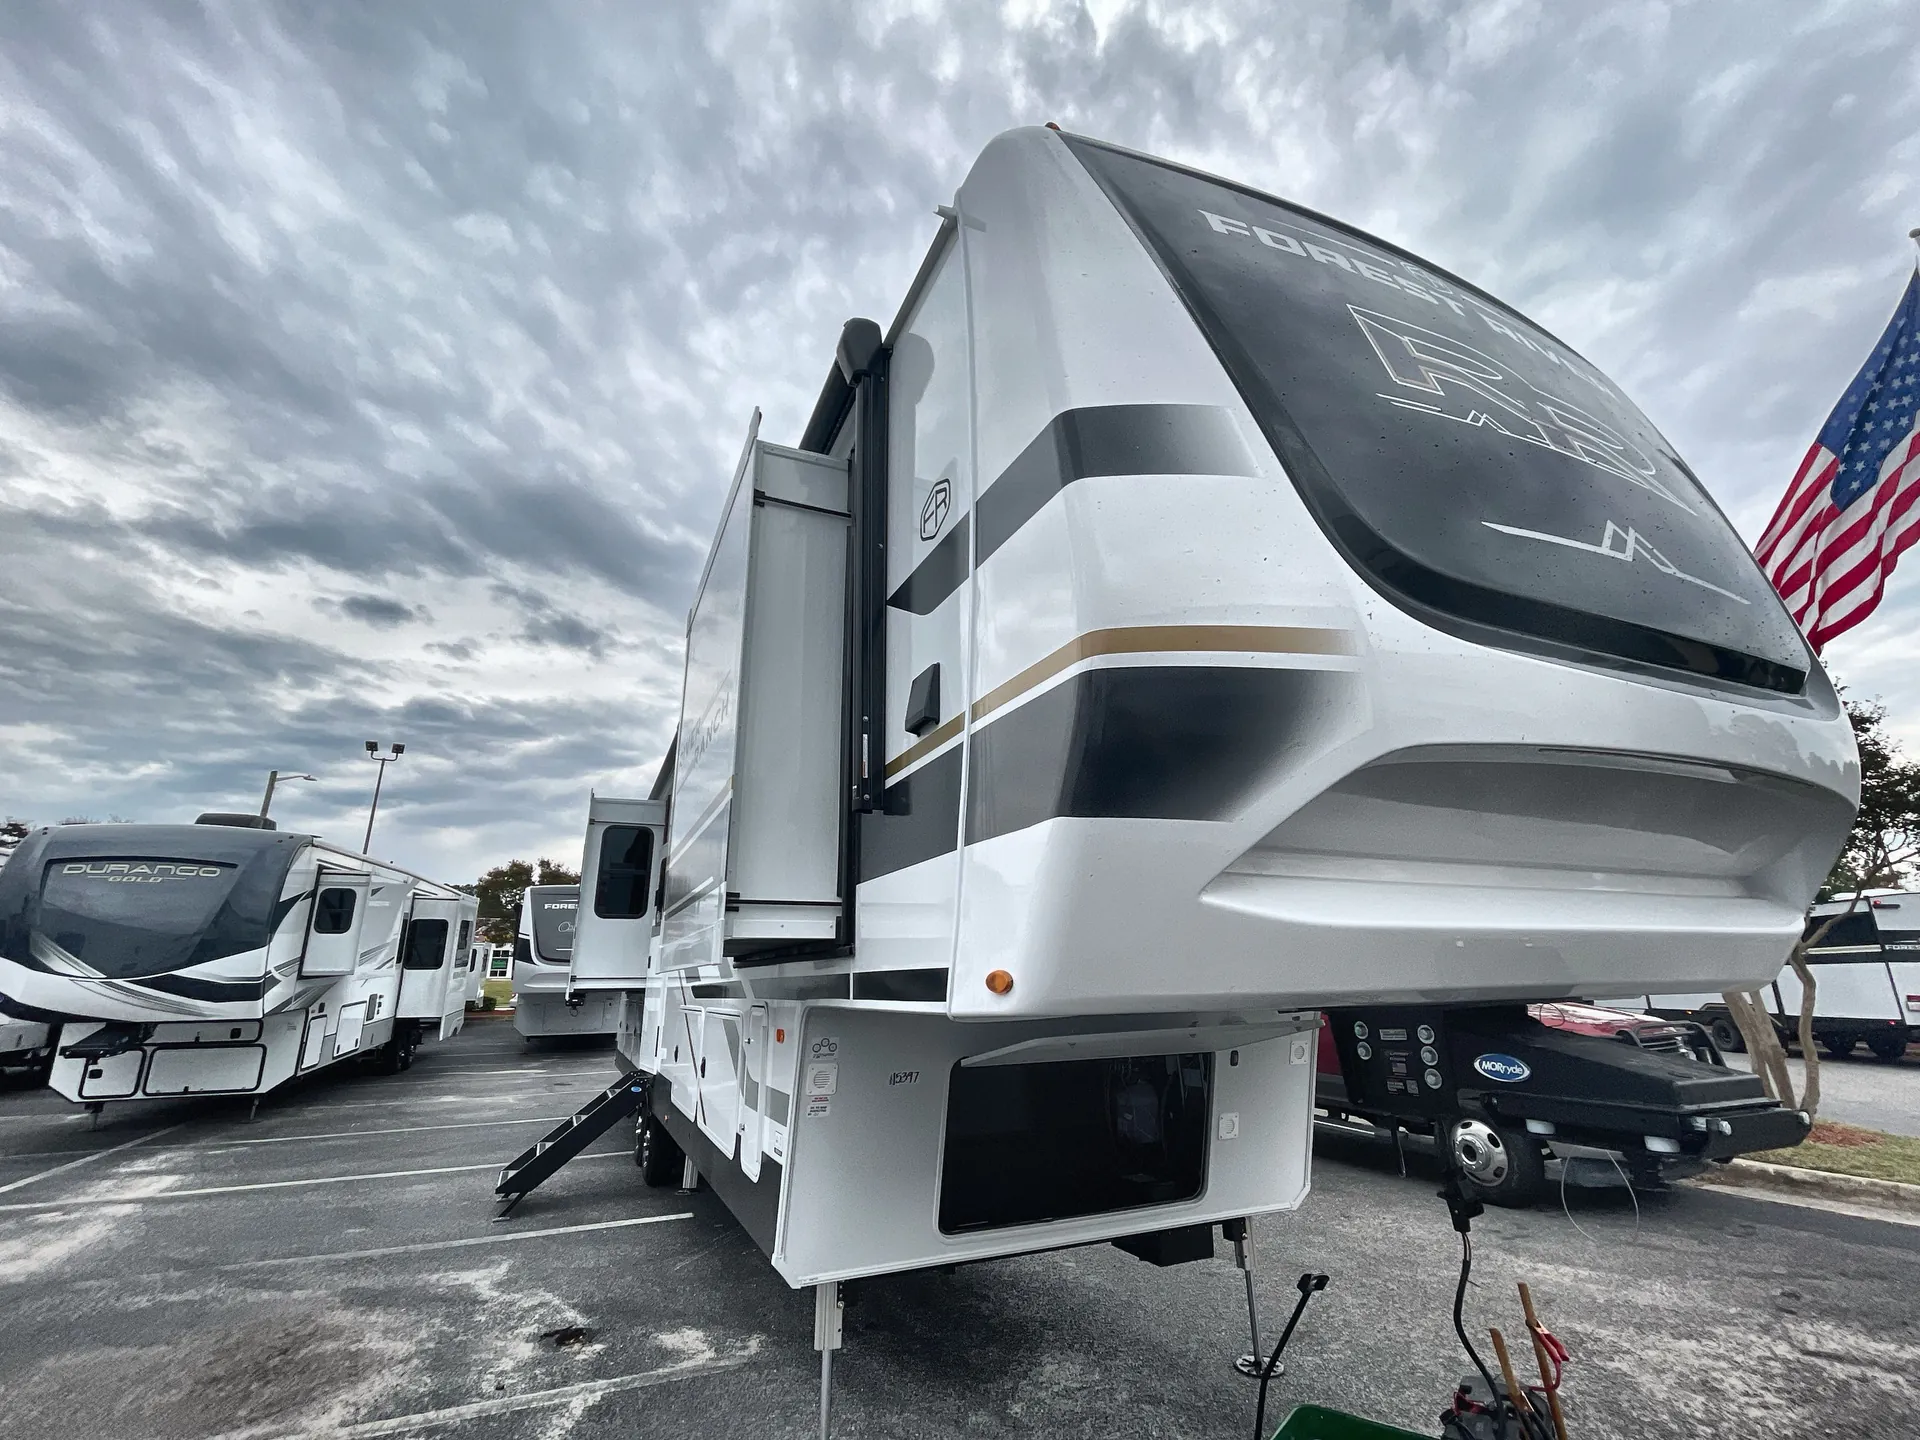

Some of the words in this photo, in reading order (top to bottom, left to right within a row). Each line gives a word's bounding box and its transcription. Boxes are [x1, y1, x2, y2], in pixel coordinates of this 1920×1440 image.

[1198, 209, 1465, 317] FOREST
[62, 863, 220, 877] DURANGO
[108, 875, 162, 883] GOLD
